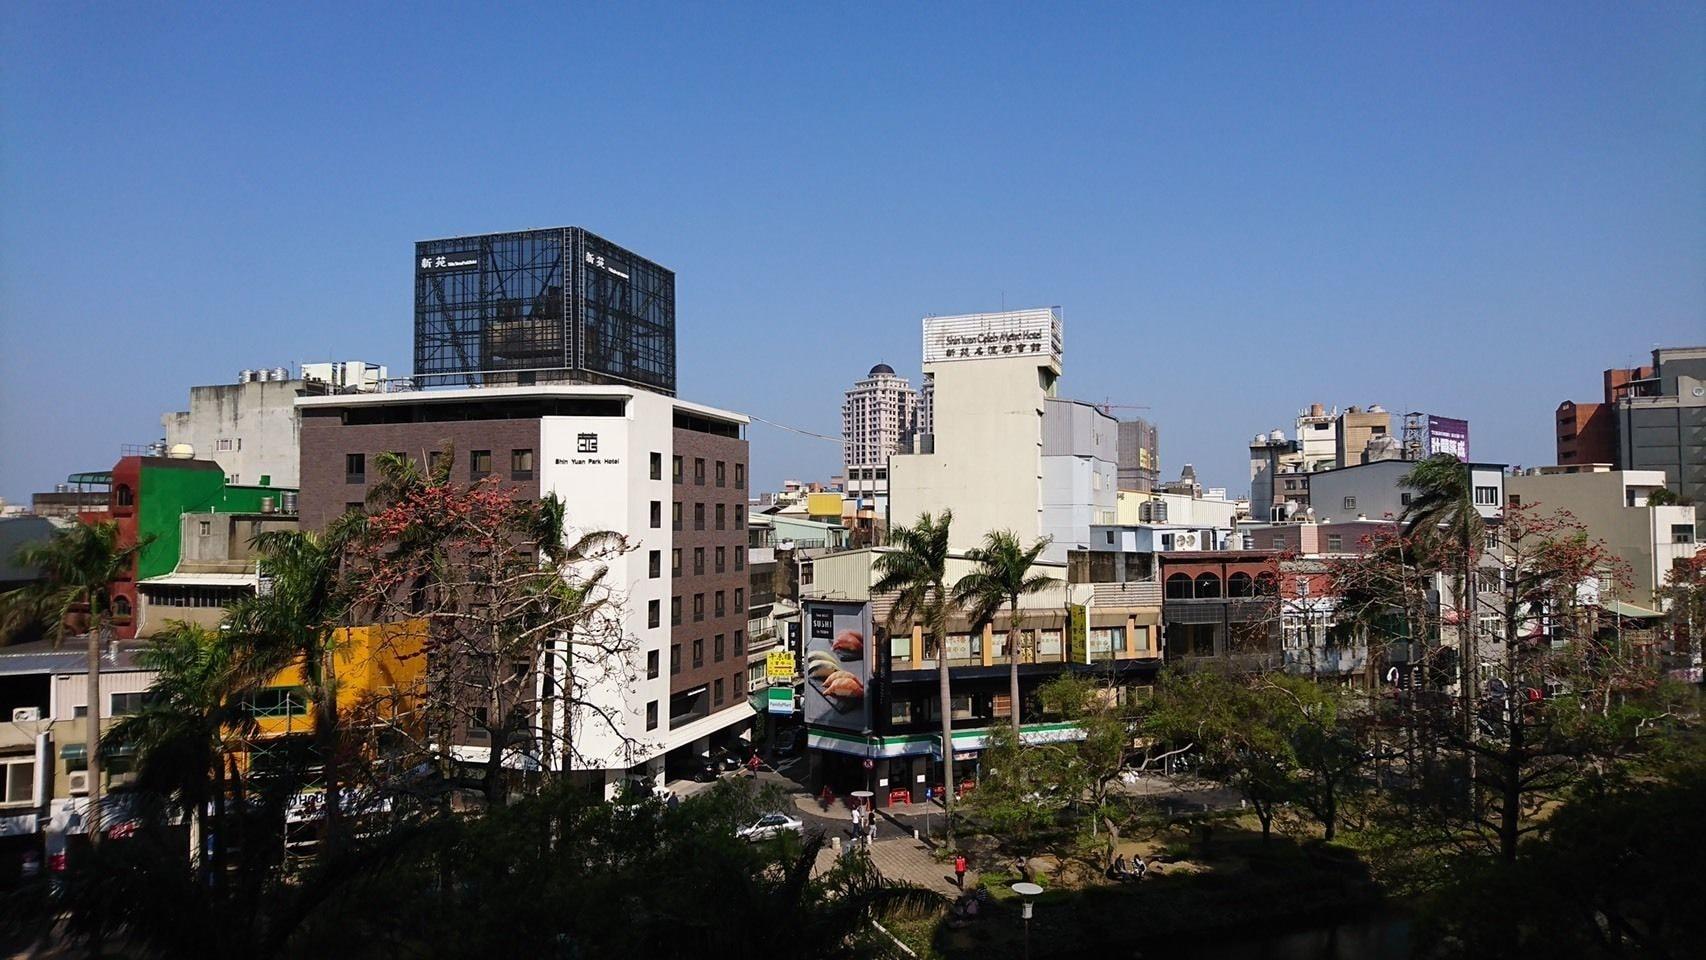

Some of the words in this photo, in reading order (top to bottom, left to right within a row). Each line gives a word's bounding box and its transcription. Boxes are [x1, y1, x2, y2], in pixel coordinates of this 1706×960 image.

[421, 256, 446, 268] 新苑
[585, 251, 605, 269] 新苑
[946, 335, 960, 346] Shin
[1023, 328, 1042, 340] Hotel
[813, 620, 832, 628] SUSHI
